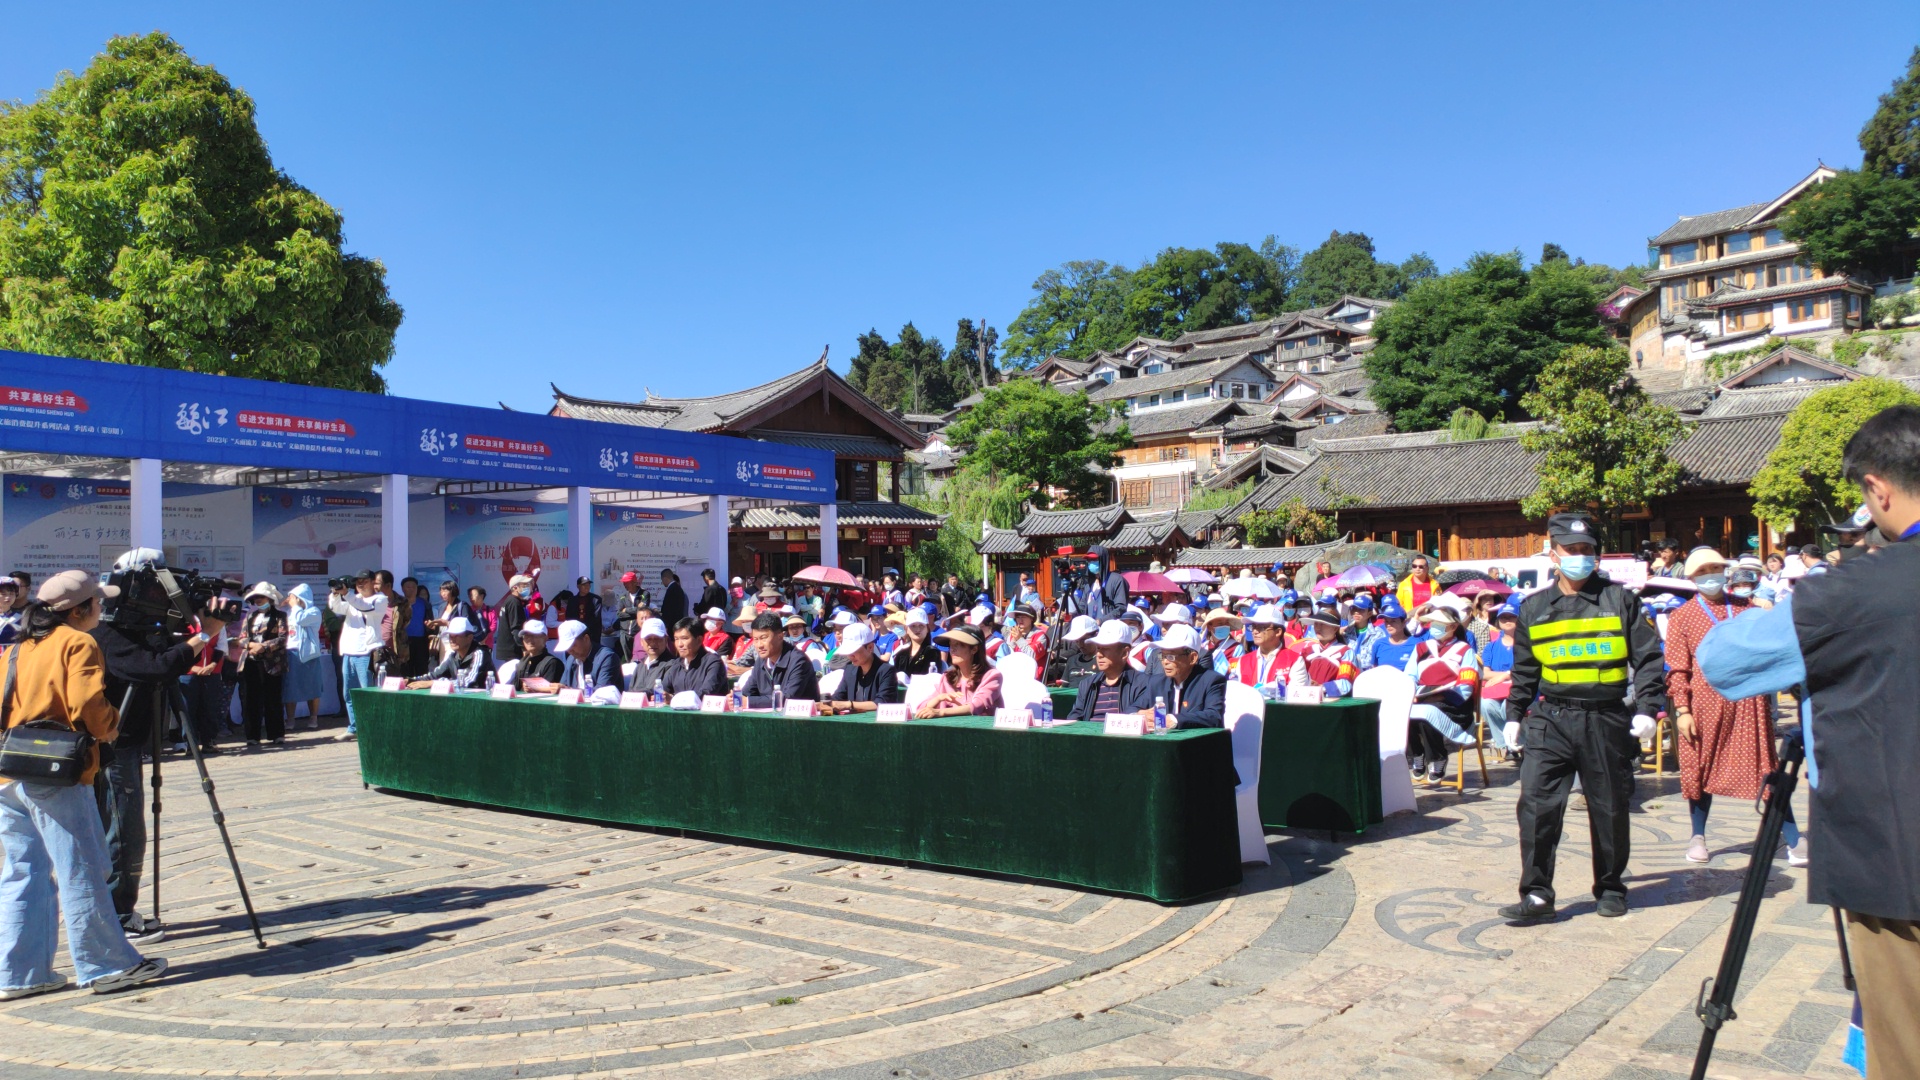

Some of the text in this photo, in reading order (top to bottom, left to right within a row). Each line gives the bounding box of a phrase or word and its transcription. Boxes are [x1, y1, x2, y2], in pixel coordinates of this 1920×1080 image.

[9, 390, 76, 406] 共享美好生活
[239, 413, 346, 433] 促进文旅消费 共享美好生活
[207, 436, 228, 444] 2023年
[466, 437, 545, 454] 促进文旅消费 共享美好生活
